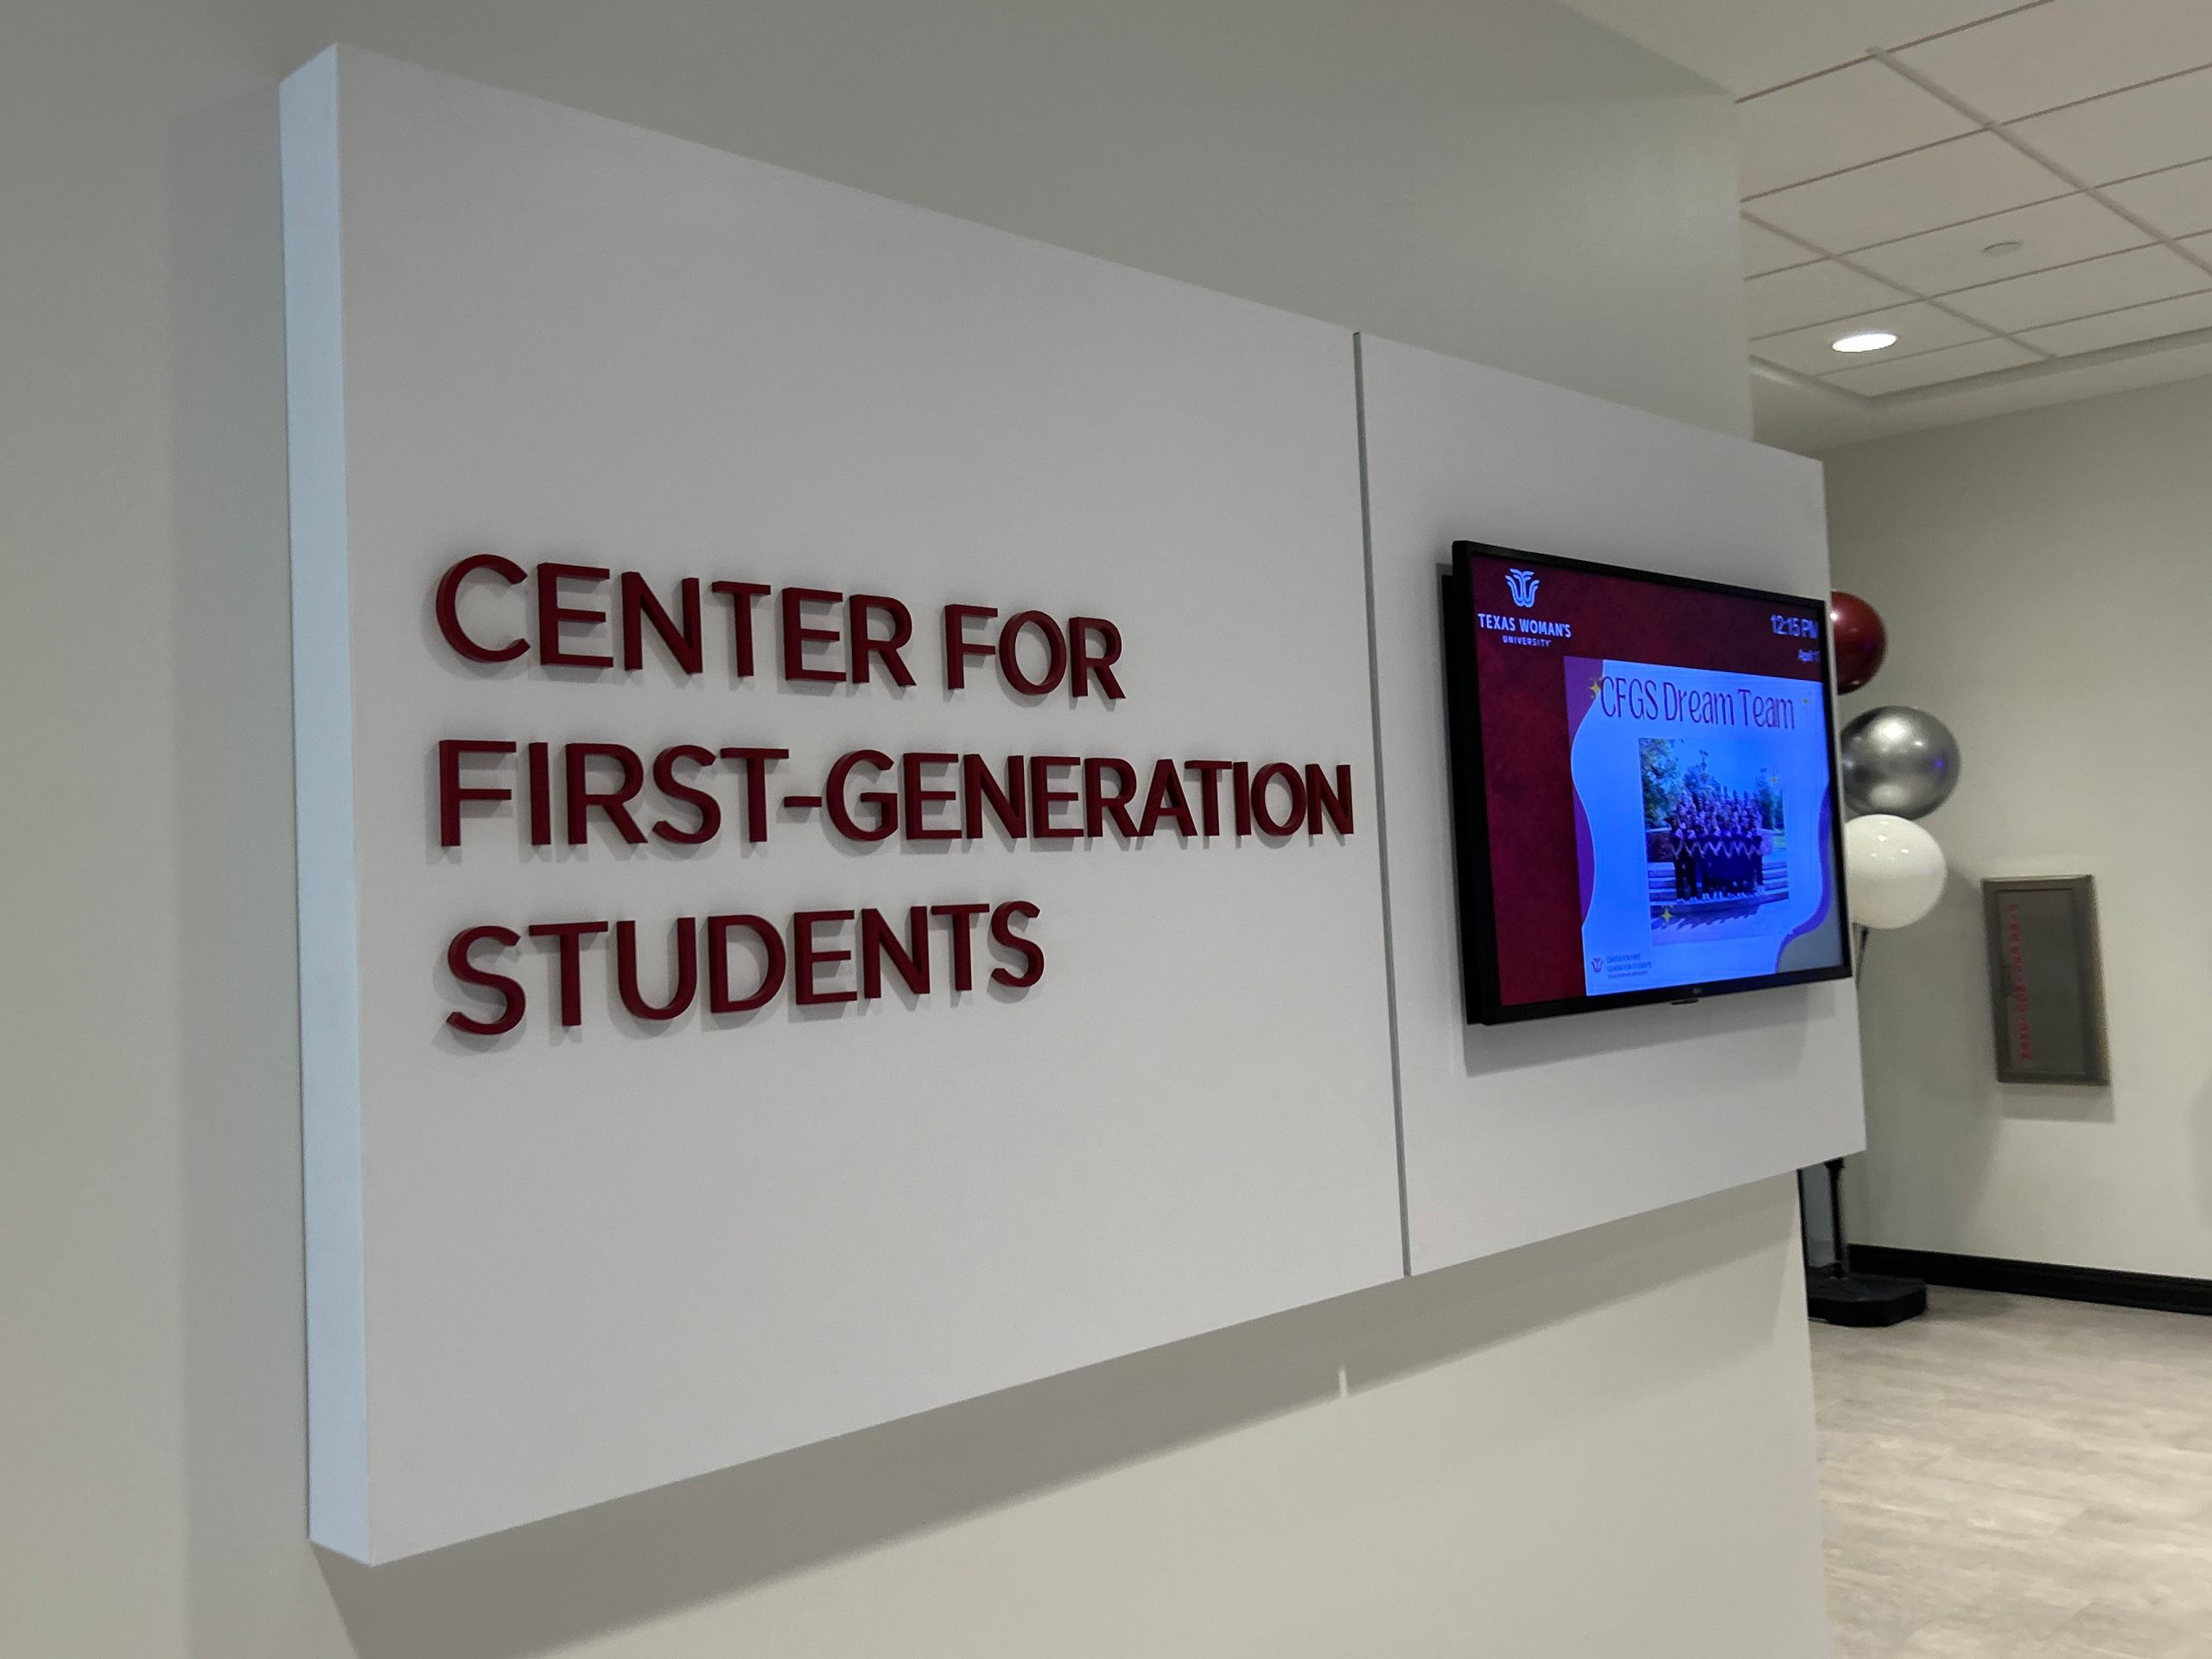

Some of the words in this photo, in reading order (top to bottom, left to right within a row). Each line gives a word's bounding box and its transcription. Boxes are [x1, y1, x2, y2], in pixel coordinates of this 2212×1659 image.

[435, 554, 916, 686] CENTER
[943, 602, 1126, 699] FOR
[1478, 613, 1516, 632] TEXAS
[1518, 618, 1572, 638] WOMAN'S
[1502, 635, 1552, 647] UNIVERSITY
[1600, 676, 1659, 721] CFGS
[1662, 681, 1735, 726] Dream
[1737, 688, 1796, 729] Team
[438, 739, 1355, 847] FIRST-GENERATION
[447, 900, 1046, 1035] STUDENTS
